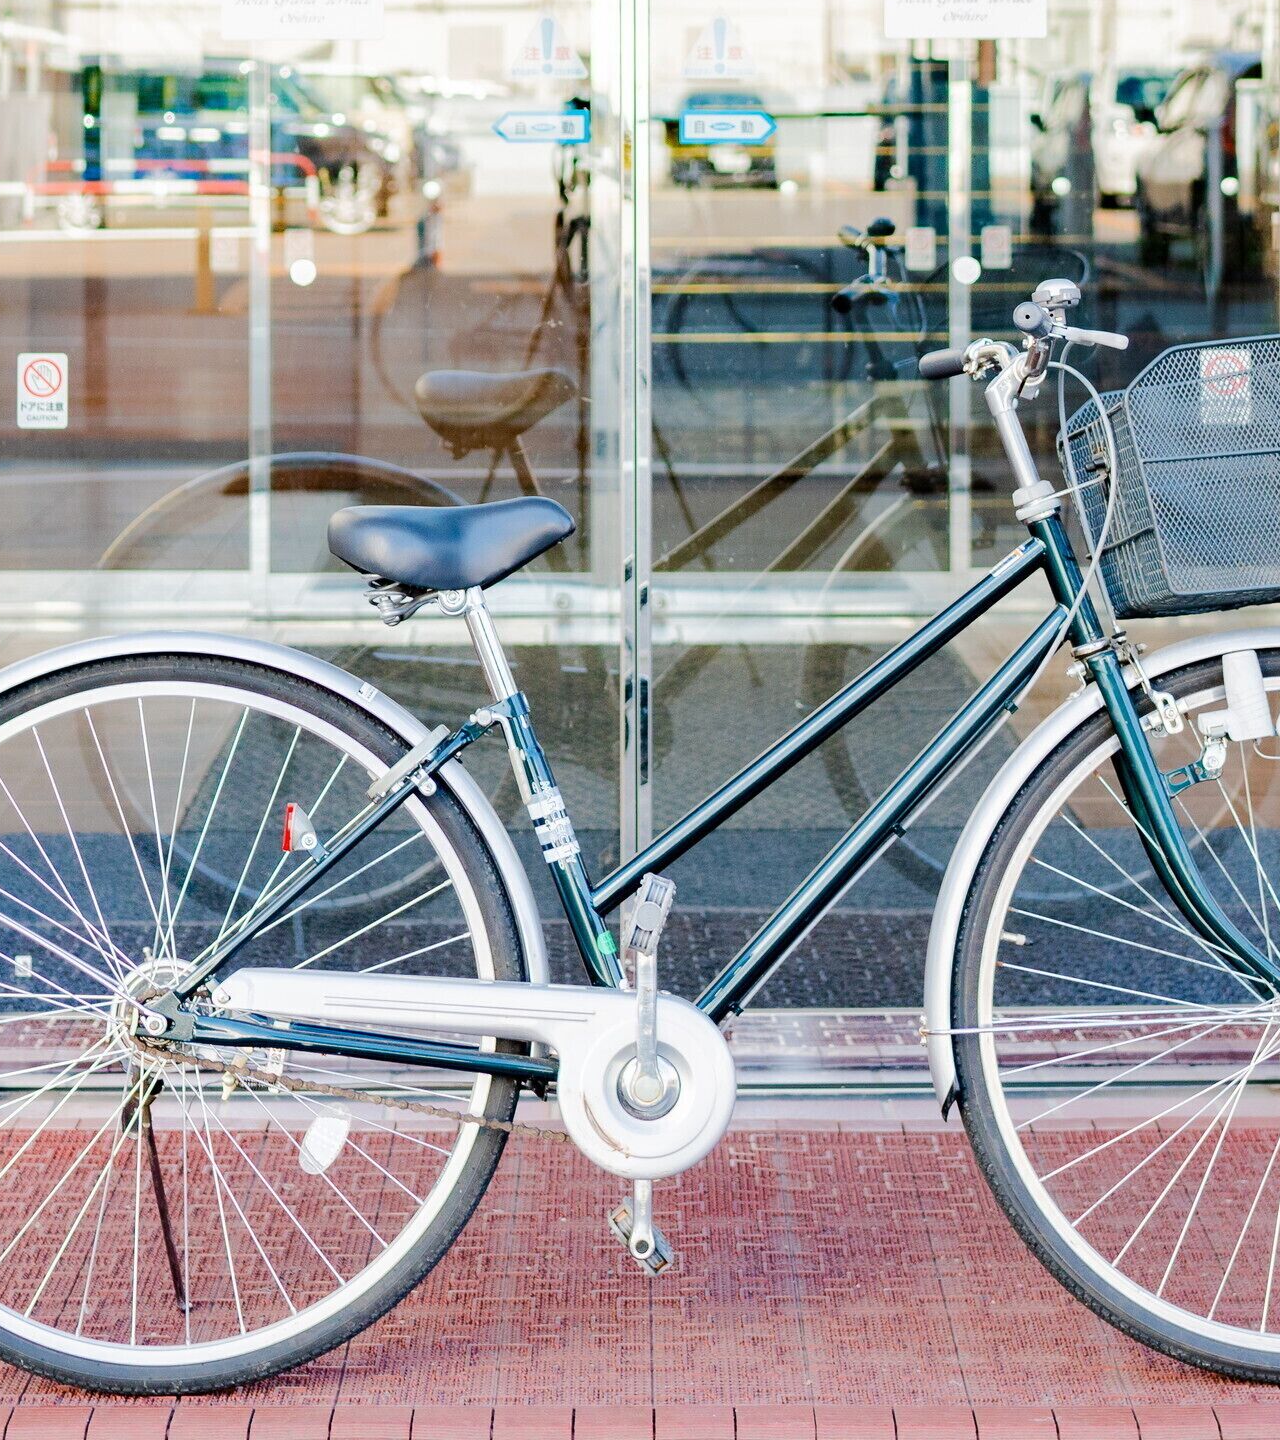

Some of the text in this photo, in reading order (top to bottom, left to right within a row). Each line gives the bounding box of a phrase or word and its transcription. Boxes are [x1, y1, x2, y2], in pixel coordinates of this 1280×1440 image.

[21, 401, 65, 412] ドアに注意
[26, 414, 59, 422] CAUTION
